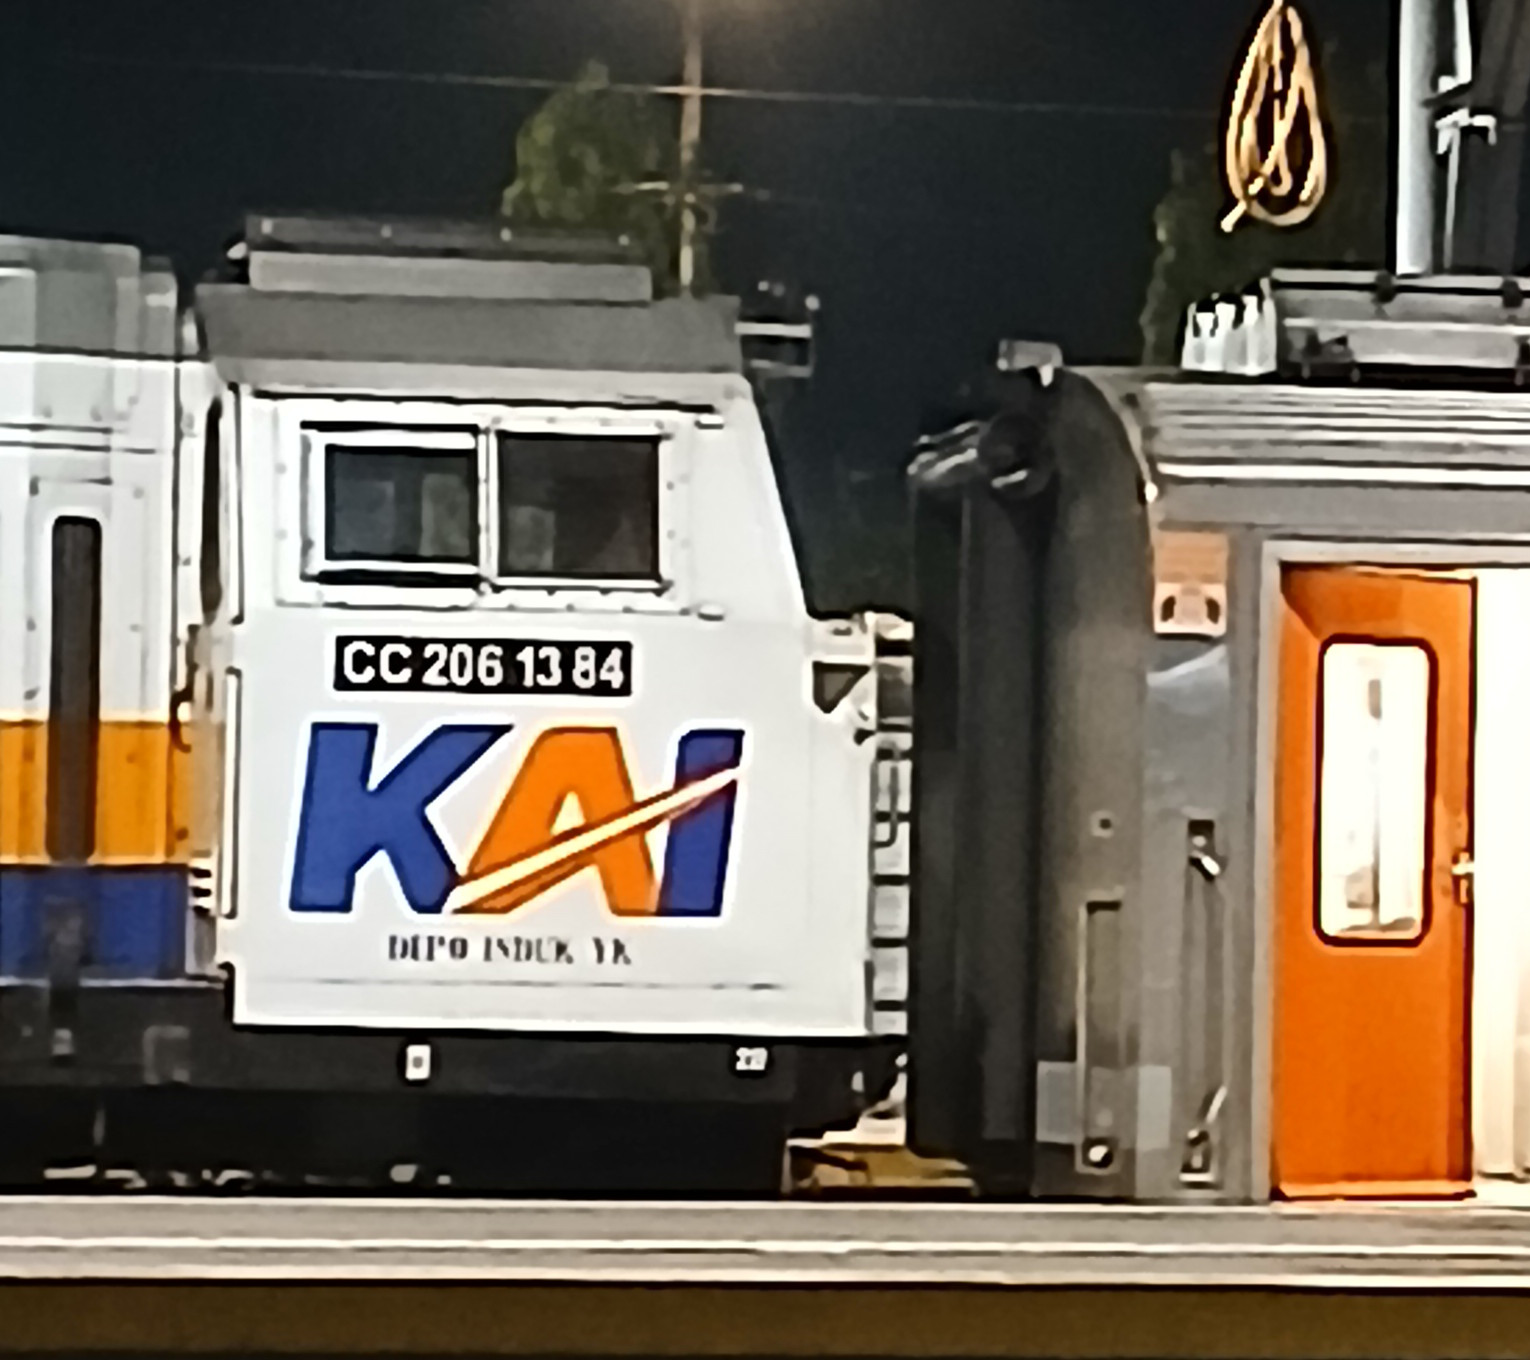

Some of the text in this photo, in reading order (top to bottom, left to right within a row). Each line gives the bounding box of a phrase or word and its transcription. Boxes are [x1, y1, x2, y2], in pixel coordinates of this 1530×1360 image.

[343, 640, 412, 684] CC
[422, 643, 503, 686] 206
[288, 721, 746, 918] KAI
